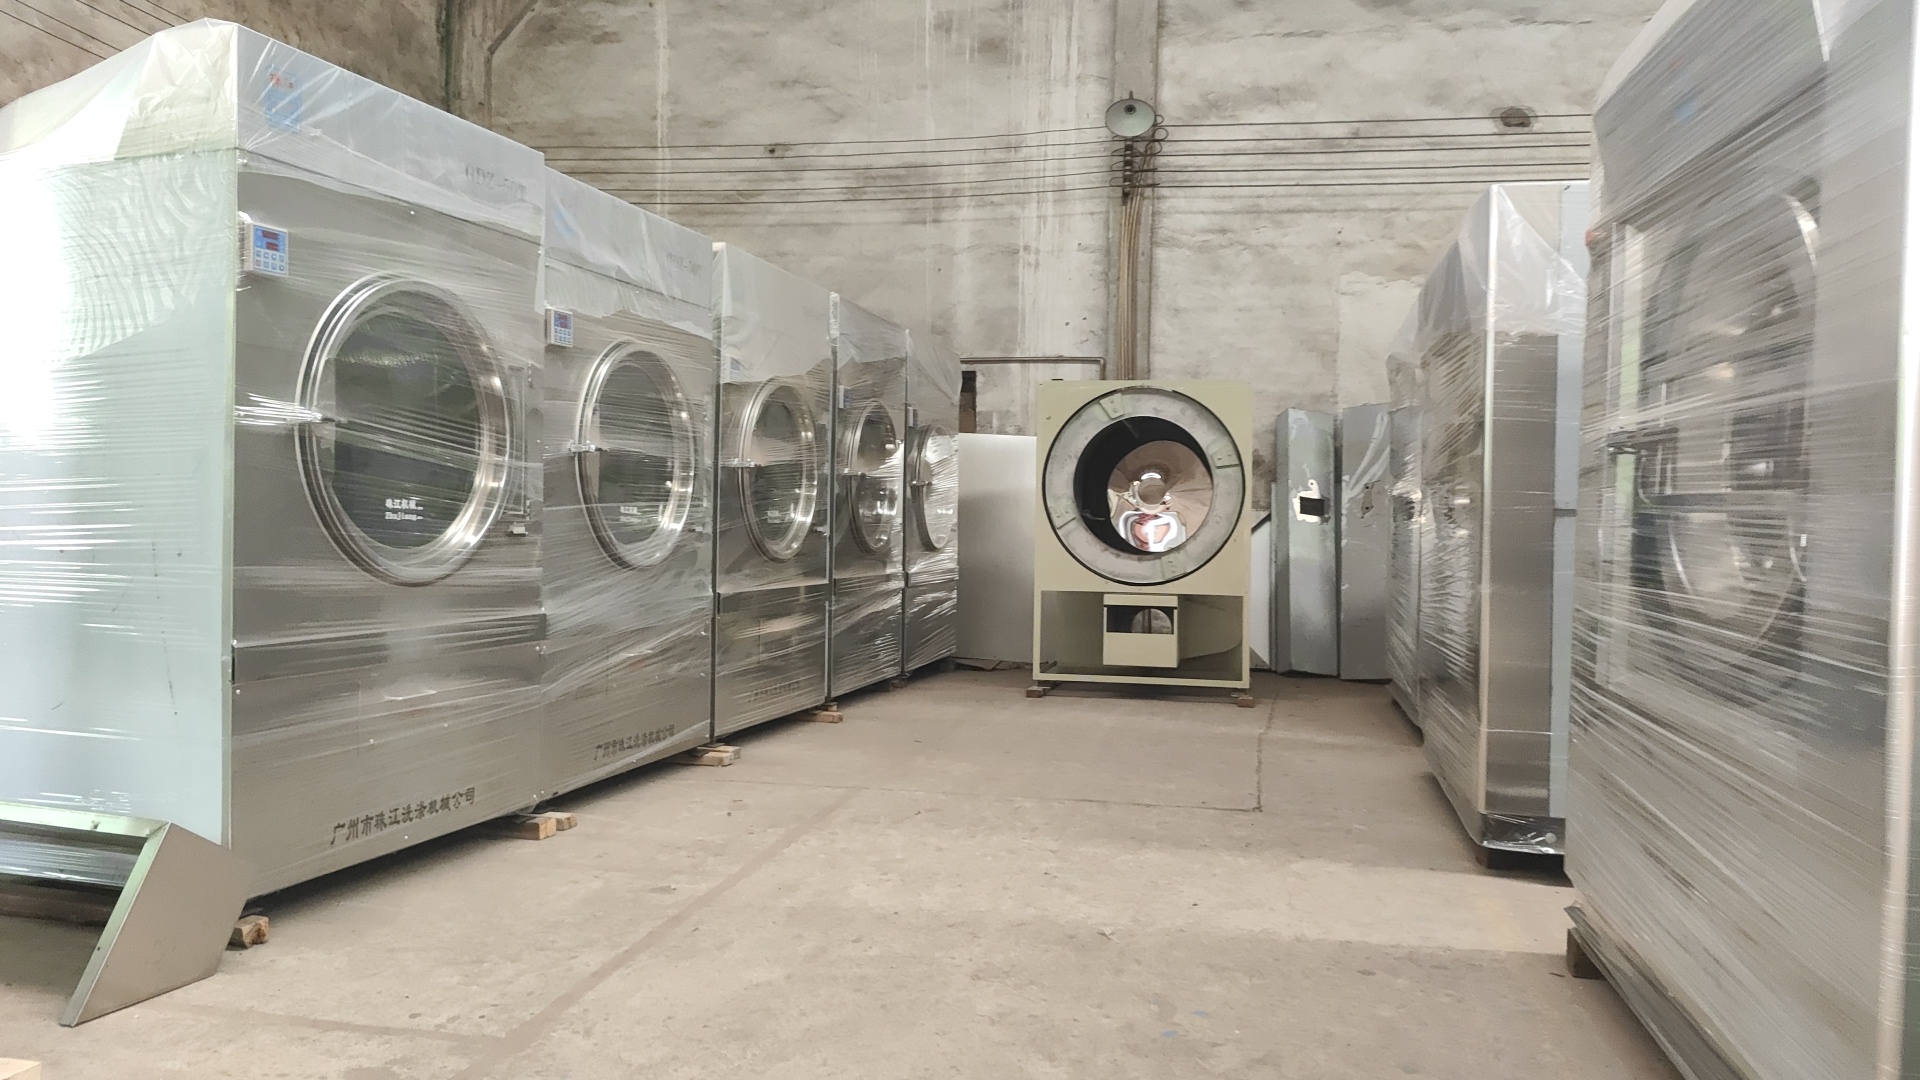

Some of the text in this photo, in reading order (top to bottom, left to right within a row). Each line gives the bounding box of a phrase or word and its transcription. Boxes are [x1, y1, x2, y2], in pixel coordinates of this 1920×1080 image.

[330, 786, 476, 846] 广州市珠江洗涤机械公司
